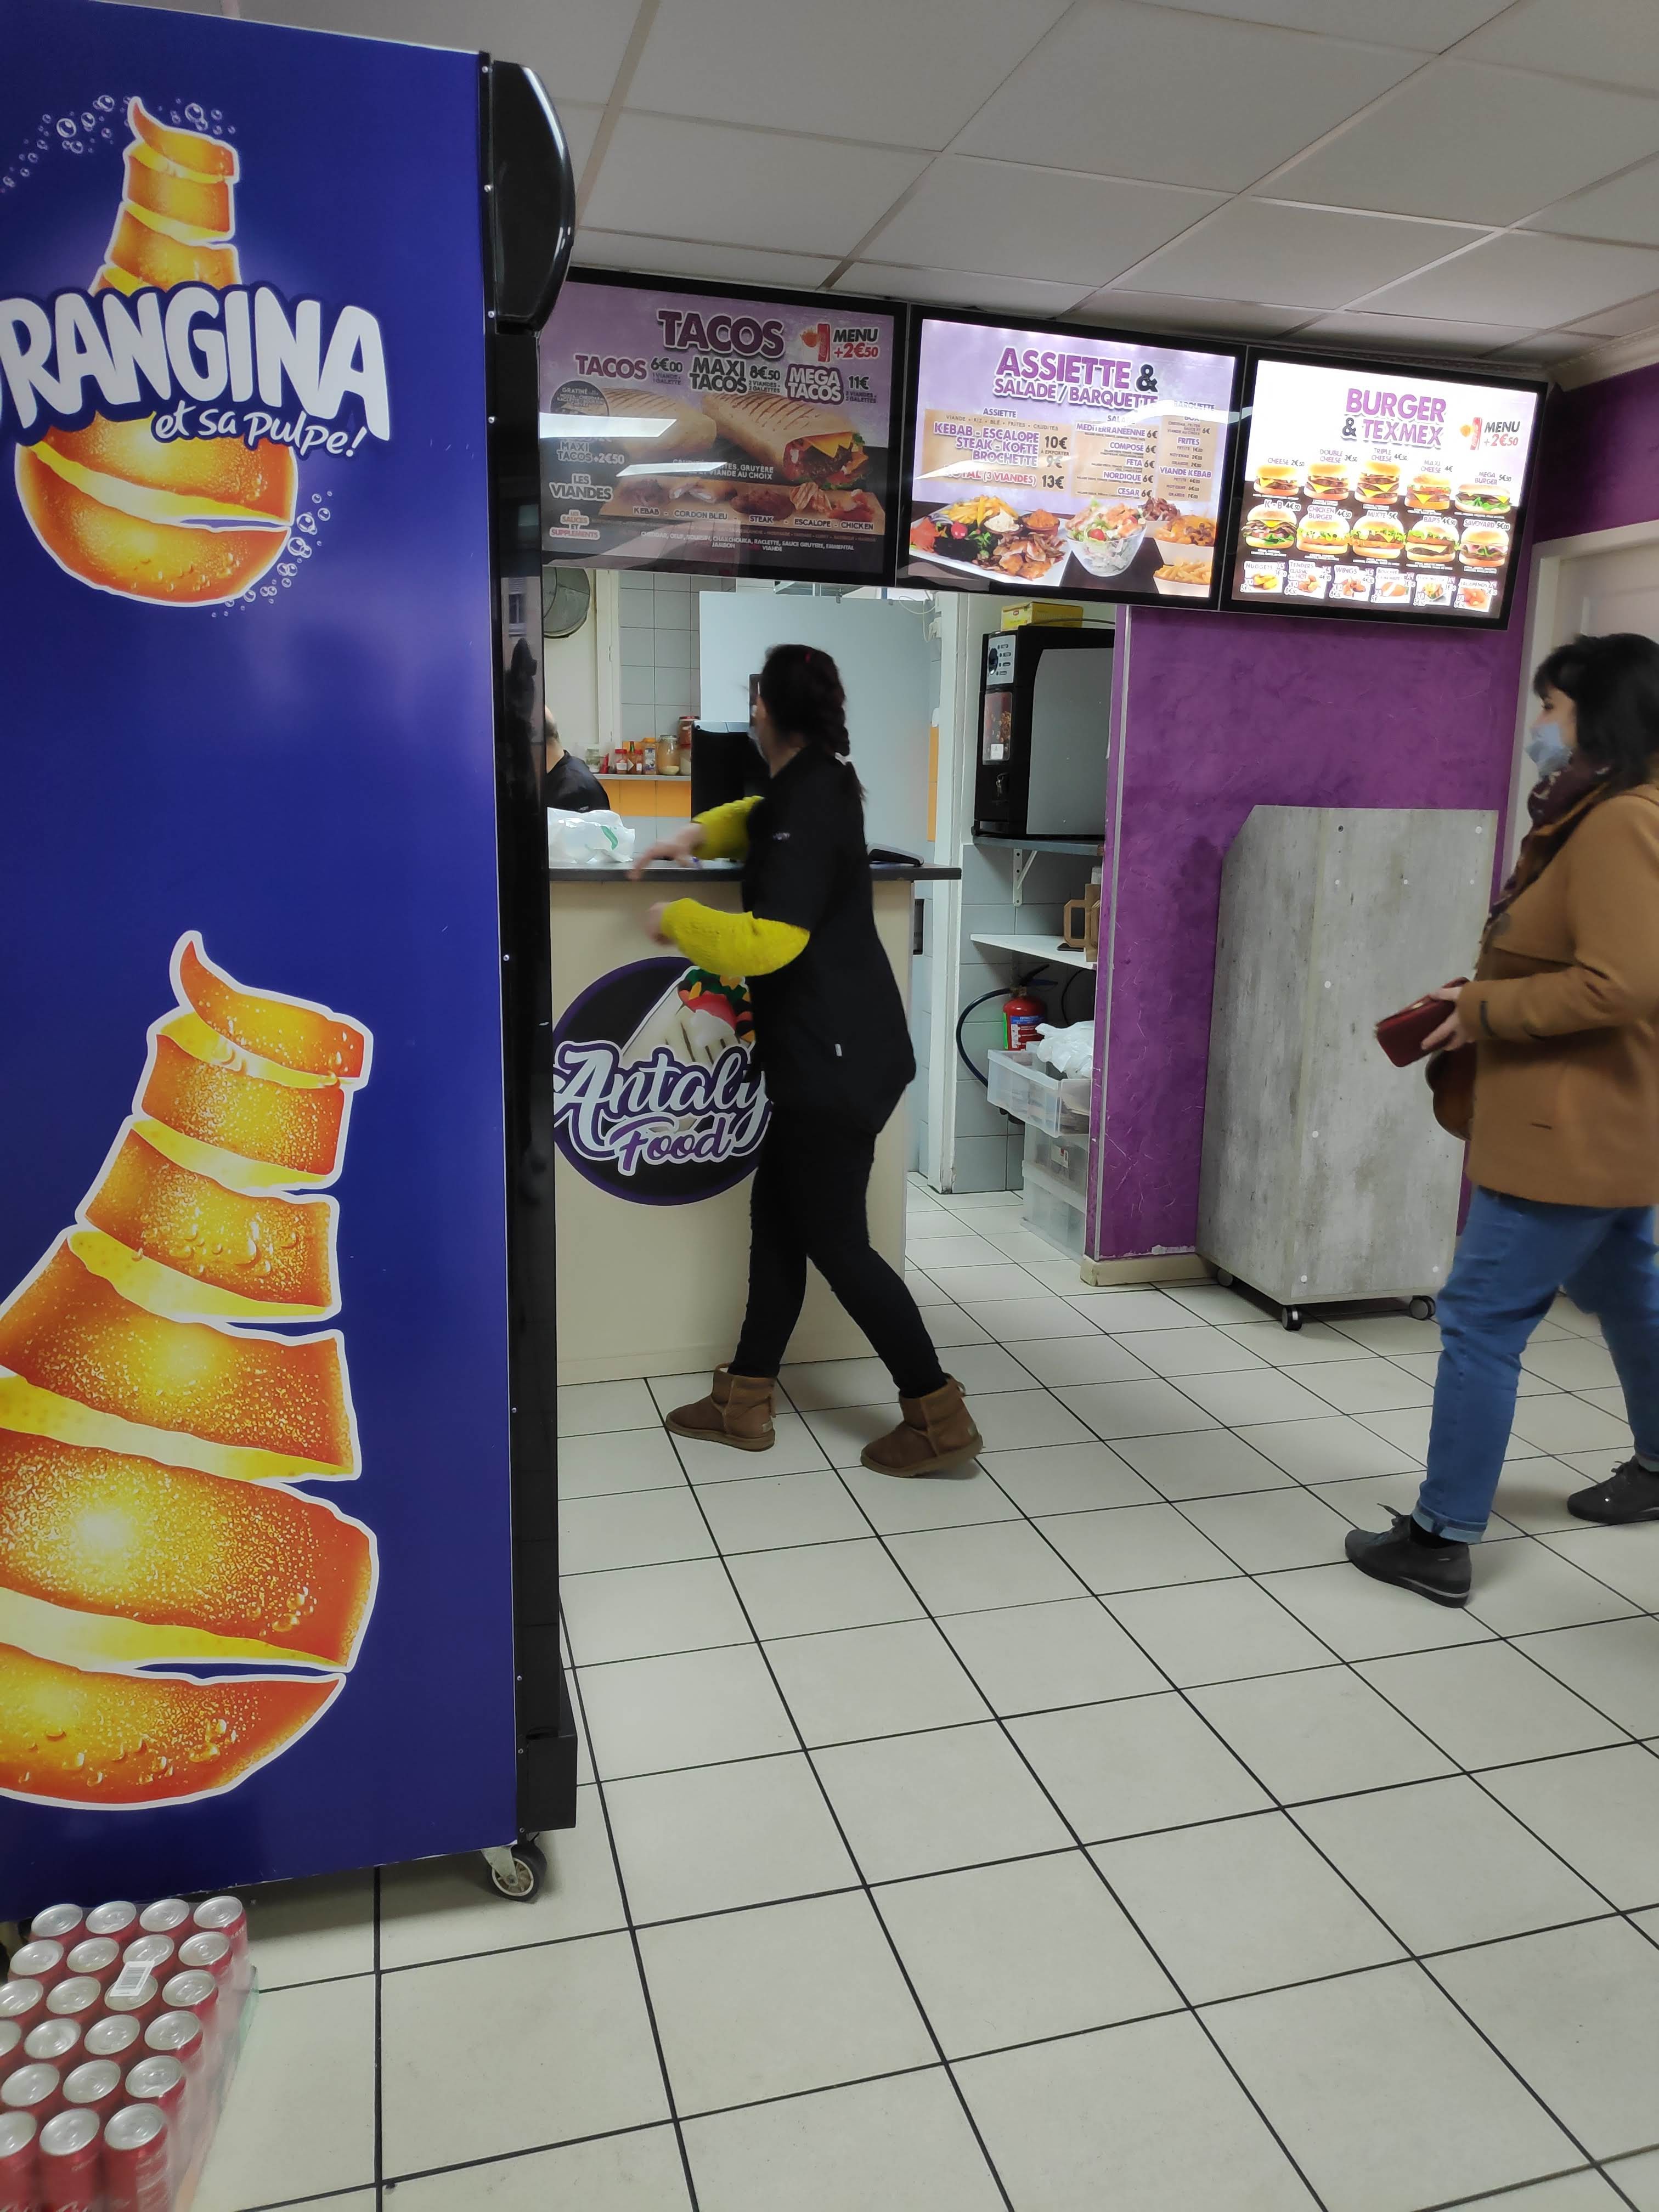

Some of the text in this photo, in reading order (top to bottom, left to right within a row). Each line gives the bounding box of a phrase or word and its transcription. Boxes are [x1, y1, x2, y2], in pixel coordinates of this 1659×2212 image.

[658, 310, 785, 358] TACOS
[833, 329, 878, 343] MENU
[833, 343, 879, 358] +2€50
[0, 287, 390, 441] RANGINA
[575, 354, 683, 380] TACOS 6€00
[692, 357, 780, 381] MAXI 8€50
[996, 348, 1159, 393] ASSIETTE &
[690, 373, 747, 394] TACOS
[789, 367, 870, 390] MEGA 11€
[788, 382, 842, 402] TACOS
[994, 379, 1057, 399] SALADE
[1070, 386, 1159, 408] BARQUETTE
[1346, 388, 1447, 423] BURGER
[983, 408, 1017, 418] ASSIETTE
[156, 400, 368, 458] et sa pulpe!
[934, 423, 1040, 443] KEBAB ESCALOPE
[1342, 417, 1443, 446] & TEXMEX
[1484, 421, 1521, 433] MENU
[1147, 430, 1158, 439] 6€
[1177, 437, 1200, 445] FRITES
[1483, 433, 1519, 447] +2€50
[561, 441, 589, 451] MAXI
[956, 437, 1039, 455] STEAK KOFTE
[1044, 436, 1068, 450] 10€
[1146, 445, 1157, 454] 6€
[557, 450, 592, 462] TACOS
[973, 450, 1039, 467] BROCHETTE
[1319, 449, 1343, 457] DOUBLE
[1372, 454, 1392, 462] CHEESE
[741, 464, 774, 473] GRUYÈRE
[1046, 455, 1063, 469] 9€
[1144, 460, 1155, 469] 6€
[1103, 472, 1142, 482] NORDIQUE
[1142, 475, 1154, 483] 6€
[1160, 466, 1211, 478] VIANDE KEBAB
[573, 475, 589, 484] LES
[994, 473, 1036, 487] VIANDES)
[1041, 475, 1065, 489] 13€
[1475, 473, 1512, 486] BURGER 5€50
[550, 484, 612, 500] VIANDES
[1141, 489, 1153, 498] 6€
[1285, 503, 1301, 511] 4€50
[1308, 506, 1335, 514] CHICKEN
[674, 510, 708, 518] CORDON
[794, 518, 831, 528] ESCALOPE
[841, 522, 873, 531] CHICKEN
[1464, 520, 1510, 530] SAVOYARD 5€00
[553, 1048, 770, 1153] Antaly
[608, 1115, 731, 1172] Food
